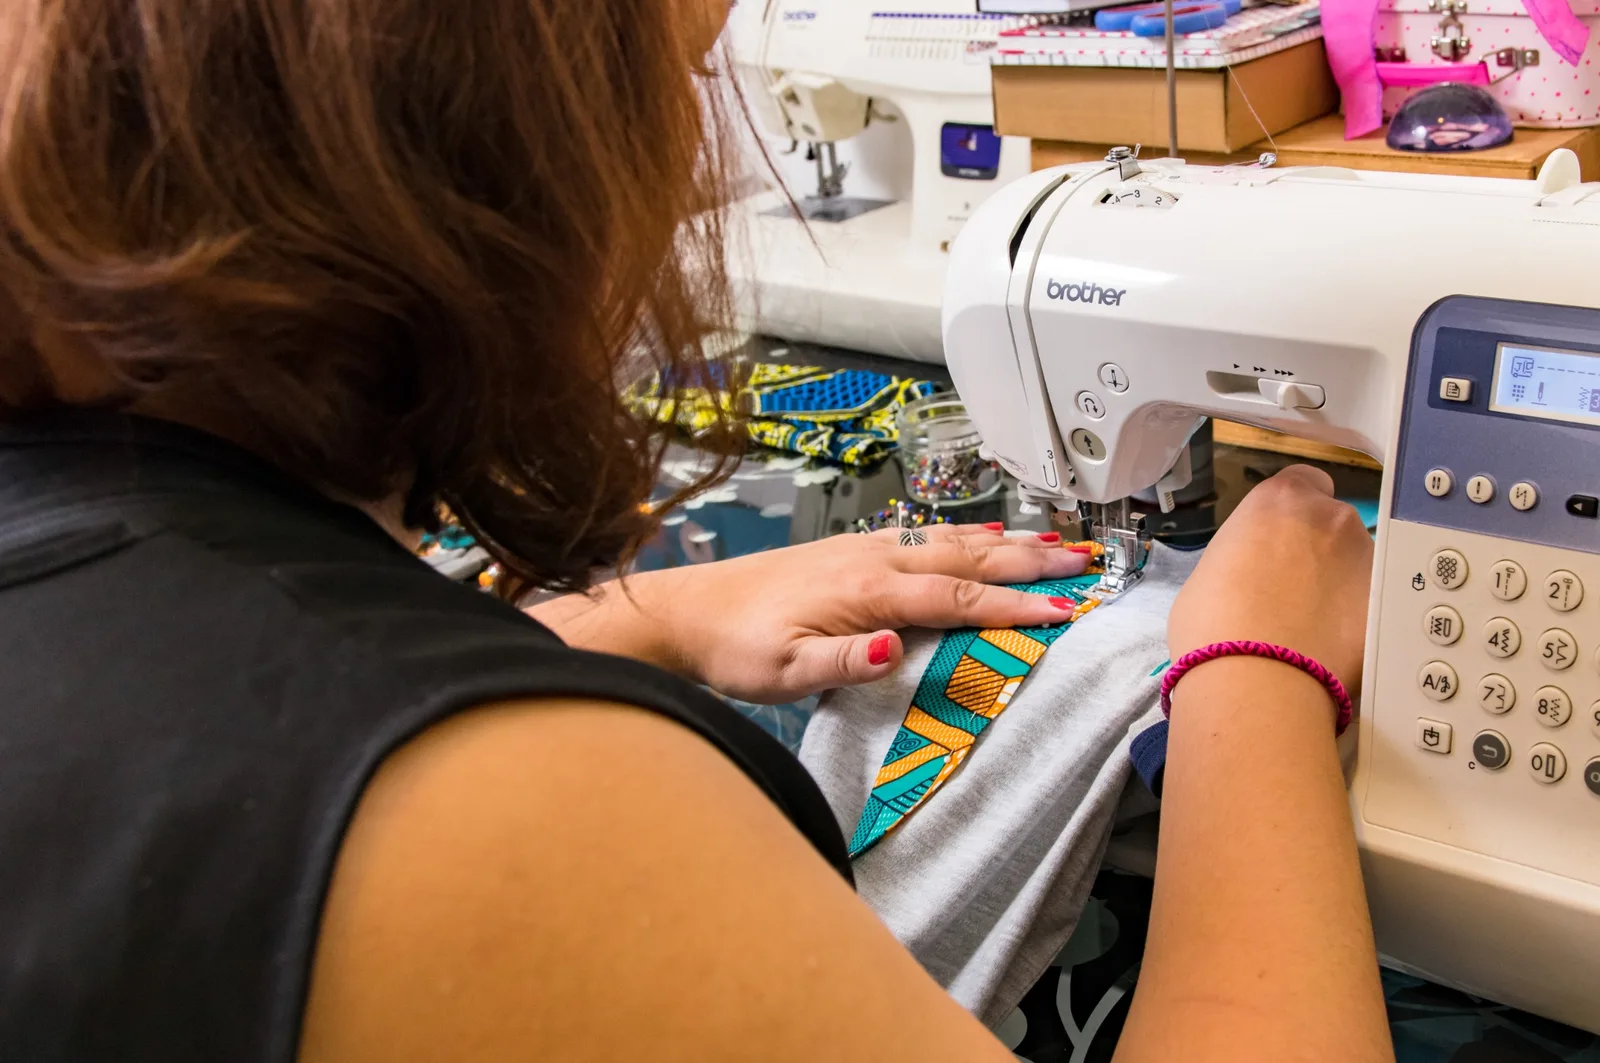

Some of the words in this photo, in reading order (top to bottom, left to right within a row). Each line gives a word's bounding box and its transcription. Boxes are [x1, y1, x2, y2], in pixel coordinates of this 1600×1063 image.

[1134, 189, 1141, 198] 3
[1155, 196, 1163, 205] 2
[1047, 277, 1126, 306] brother
[1046, 449, 1054, 460] 3
[1495, 572, 1501, 588] 1
[1548, 582, 1560, 599] 2
[1488, 632, 1499, 647] 4
[1542, 642, 1554, 658] 5
[1483, 685, 1495, 701] 7
[1537, 698, 1548, 715] 8
